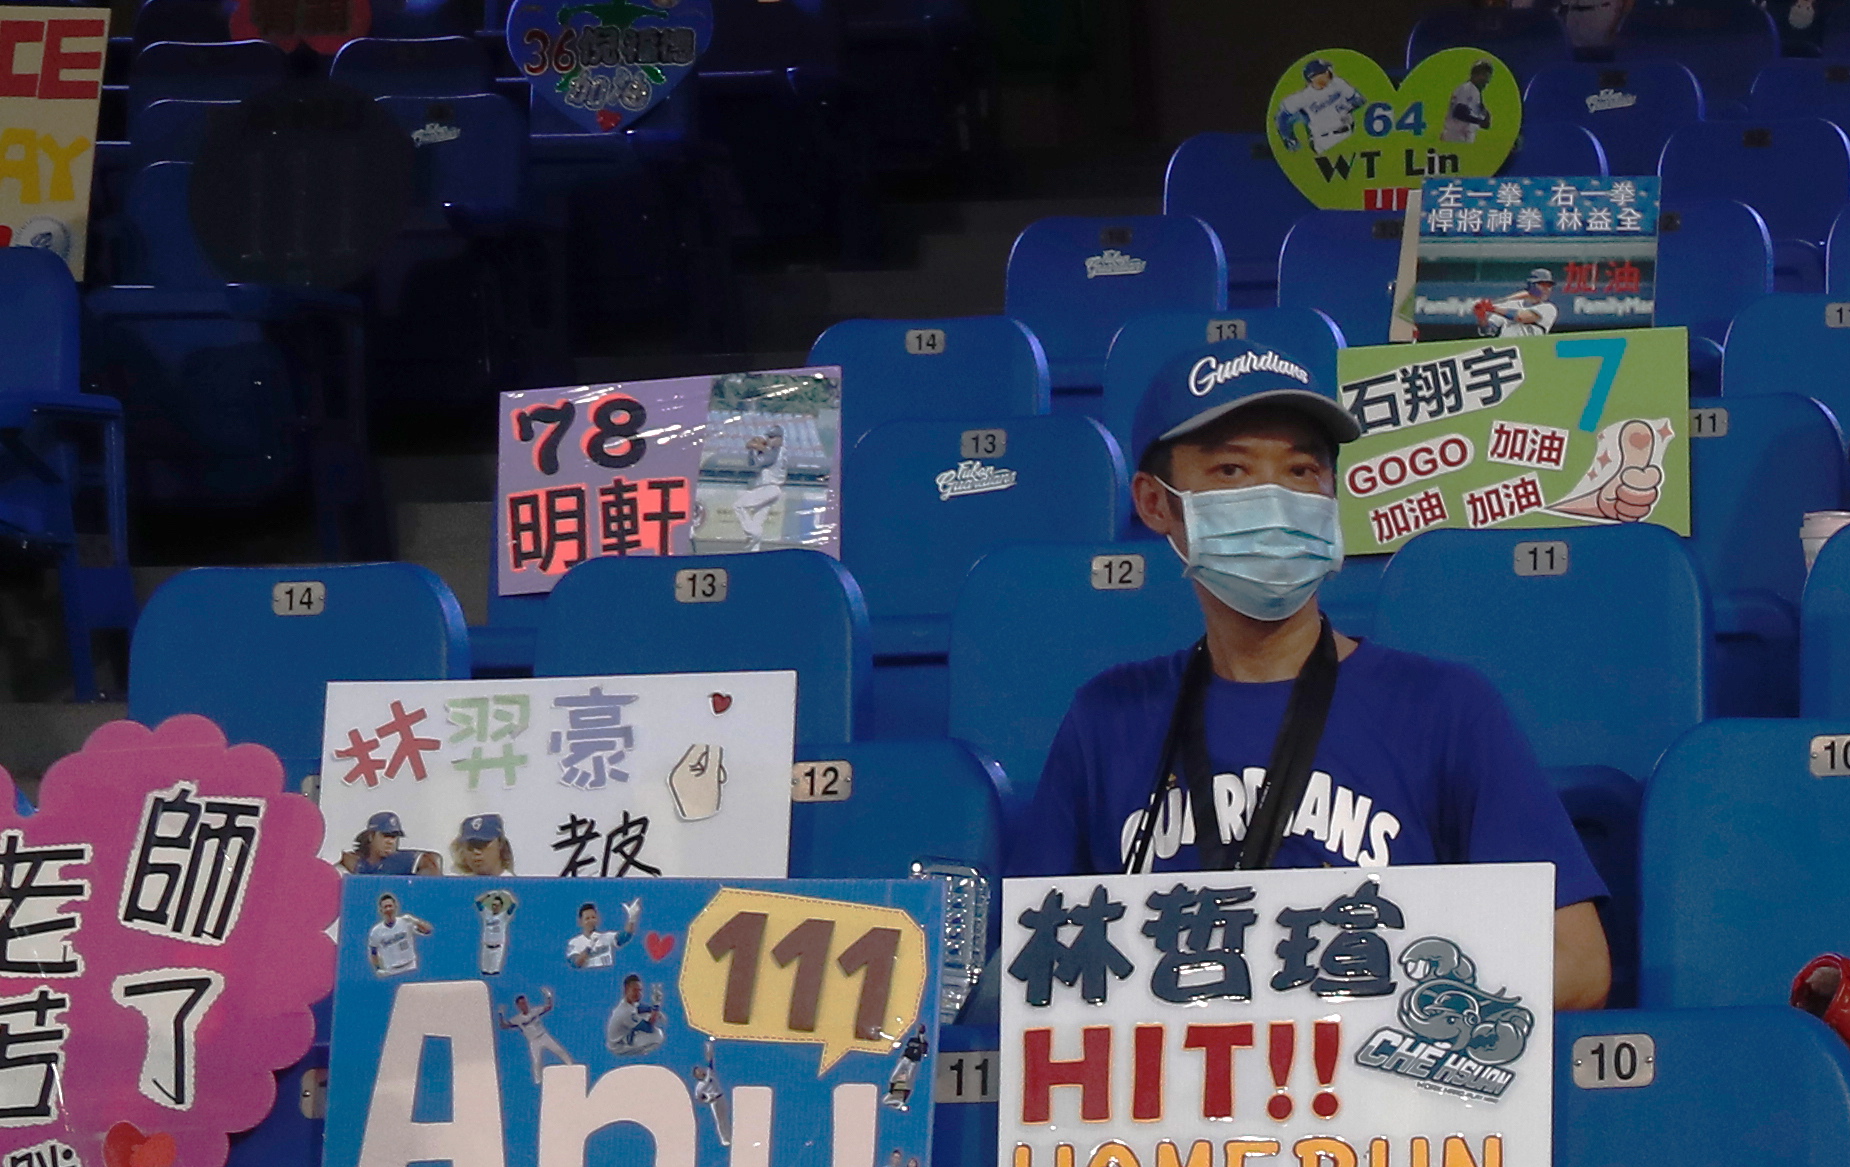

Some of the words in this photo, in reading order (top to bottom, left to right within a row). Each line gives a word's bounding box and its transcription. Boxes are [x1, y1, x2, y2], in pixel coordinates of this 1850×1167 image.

[524, 28, 577, 76] 36
[1364, 102, 1426, 136] 64
[1315, 151, 1381, 183] WT
[1405, 148, 1459, 176] Lin
[1437, 183, 1522, 208] 左一拳
[1551, 182, 1636, 206] 右一拳
[1428, 208, 1542, 232] 悍將神拳
[1557, 207, 1642, 231] 林益全
[1563, 261, 1641, 293] 加油
[915, 332, 936, 351] 14
[1188, 349, 1310, 397] Guardians
[1341, 346, 1523, 435] 石翔宇
[1555, 338, 1628, 432] 7
[512, 394, 647, 475] 78
[1695, 414, 1716, 432] 11
[971, 434, 996, 454] 13
[1349, 438, 1469, 495] GOGO
[1489, 423, 1566, 467] 加油
[509, 478, 689, 573] 明軒
[1371, 488, 1448, 543] 加油
[1466, 477, 1544, 526] 加油
[1102, 561, 1132, 585] 12
[1528, 549, 1556, 571] 11
[284, 587, 313, 611] 14
[687, 573, 716, 597] 13
[334, 686, 639, 791] 林羿豪
[803, 767, 839, 795] 12
[1008, 879, 1406, 1007] 林哲瑄
[706, 911, 902, 1041] 111
[1357, 1028, 1446, 1077] CHE
[1592, 1044, 1638, 1080] 10
[949, 1061, 990, 1096] 11
[1020, 1018, 1342, 1126] HIT!!
